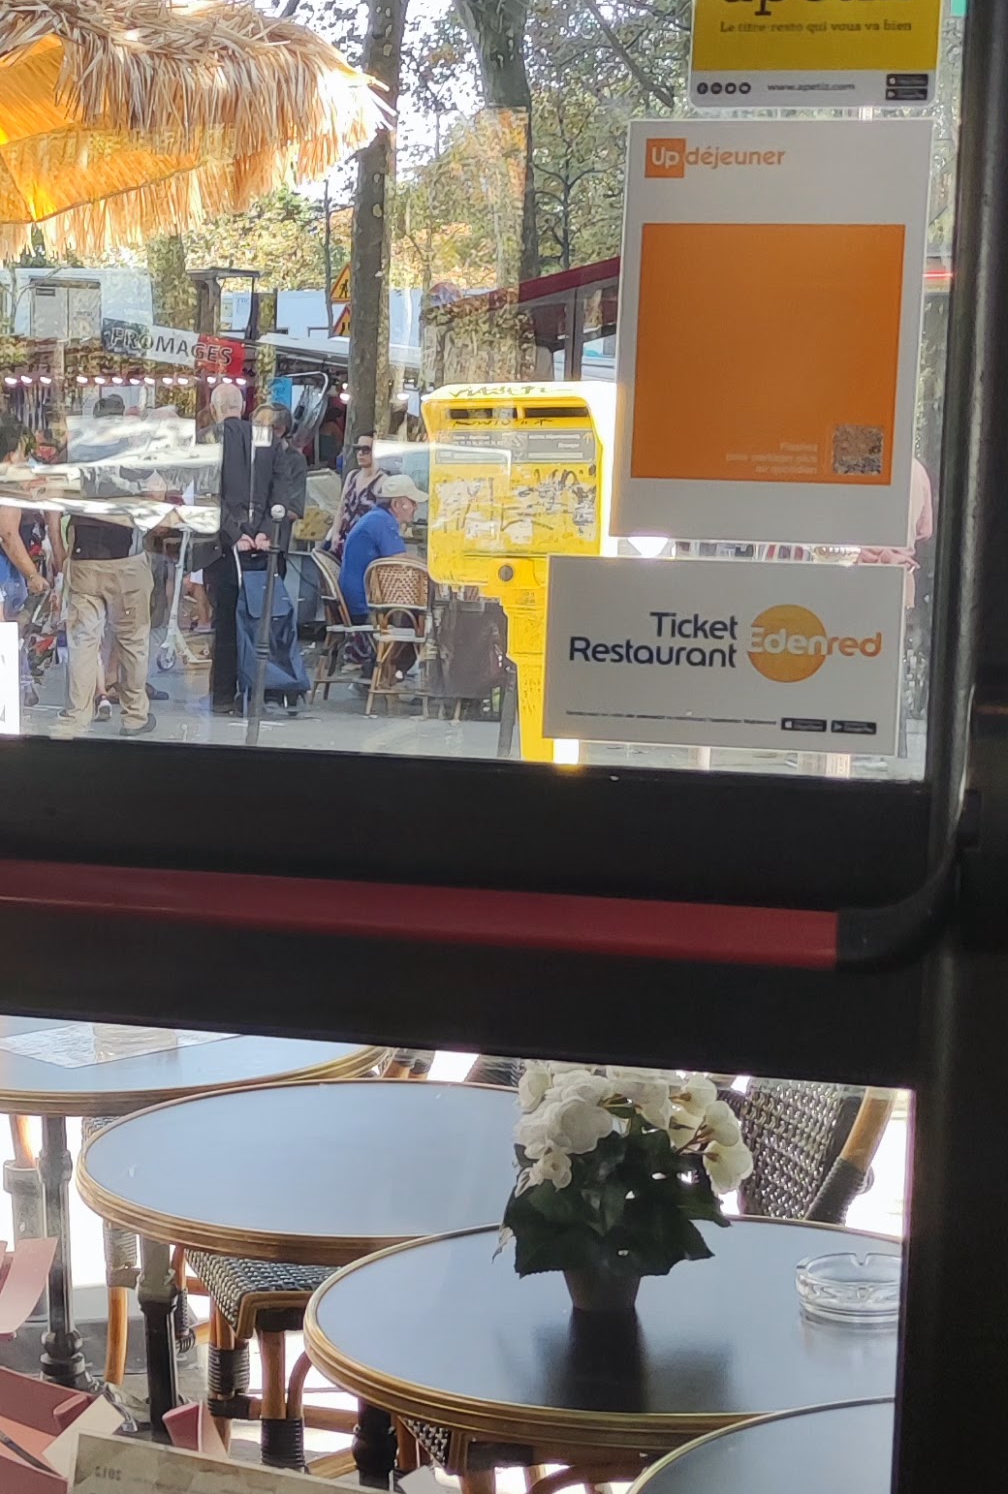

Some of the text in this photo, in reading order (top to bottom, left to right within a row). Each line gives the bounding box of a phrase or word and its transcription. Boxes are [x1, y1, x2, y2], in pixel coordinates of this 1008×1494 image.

[720, 20, 735, 33] Le
[806, 20, 828, 35] qui
[831, 21, 861, 32] vous
[864, 21, 880, 32] va
[883, 18, 912, 32] bien
[651, 145, 786, 171] Up déjeuner
[111, 327, 234, 366] FROMAGES
[650, 610, 738, 640] Ticket
[569, 636, 737, 668] Restaurant
[748, 625, 882, 658] Edenred
